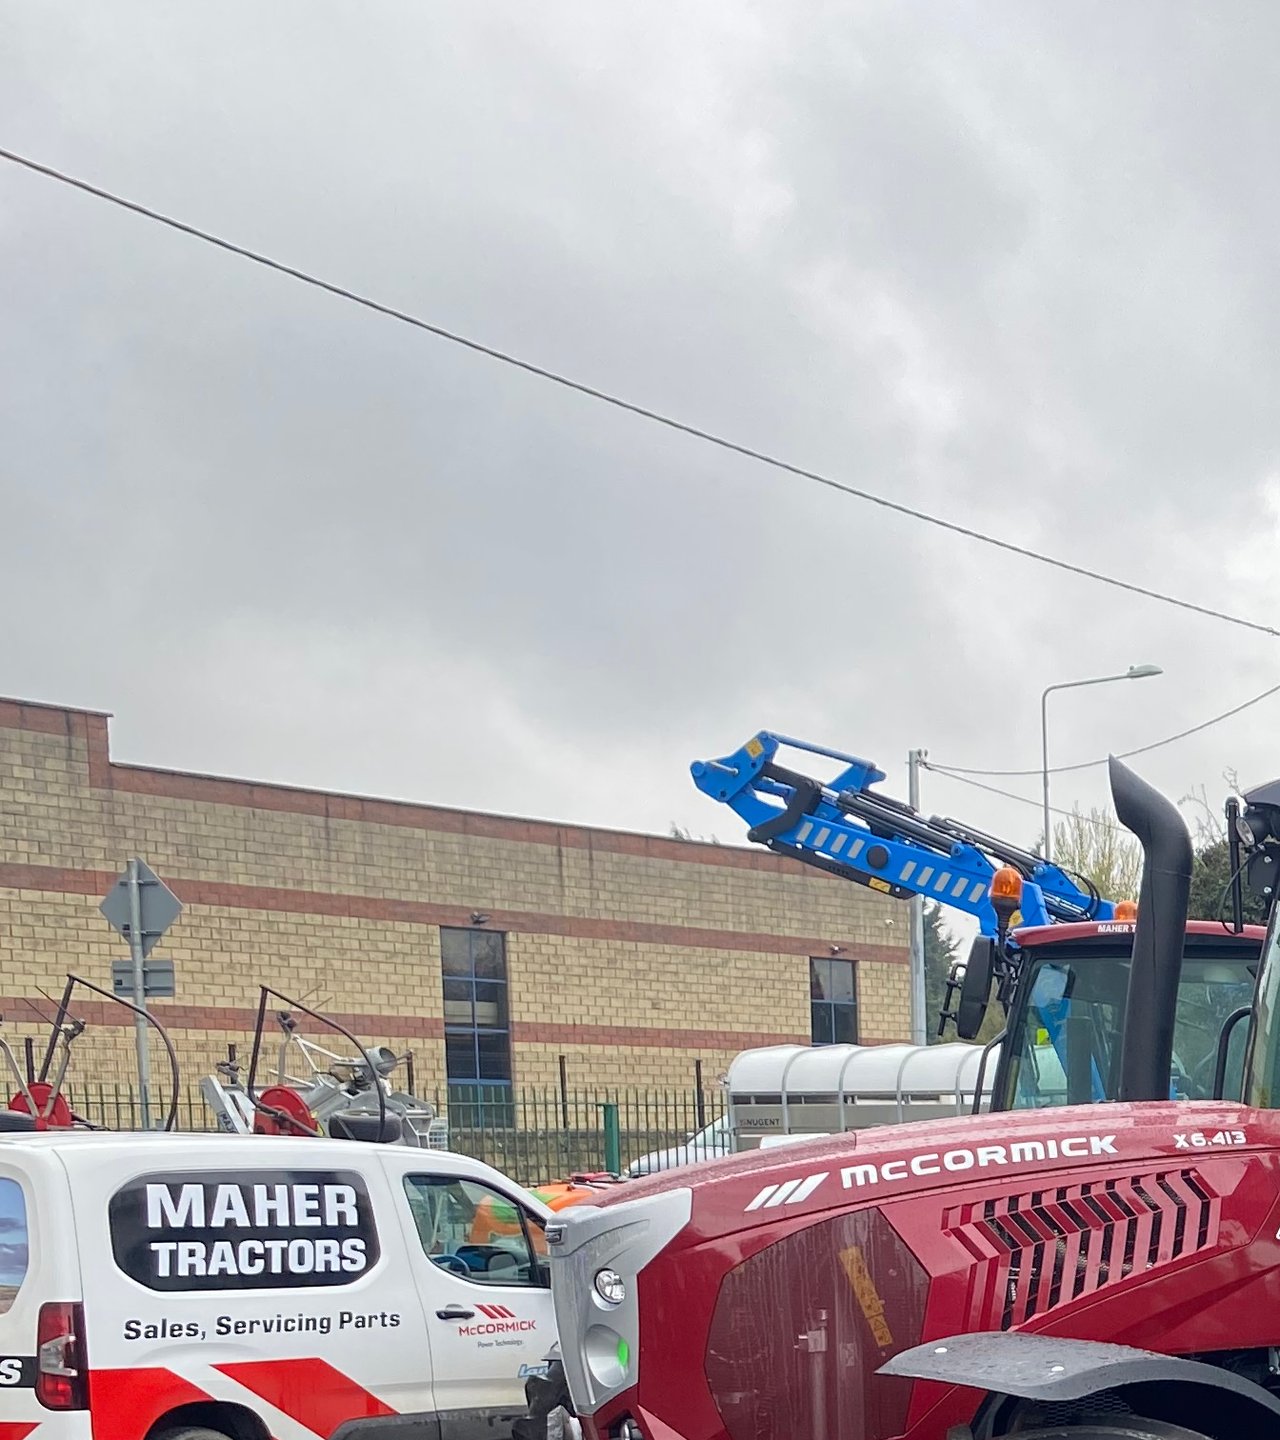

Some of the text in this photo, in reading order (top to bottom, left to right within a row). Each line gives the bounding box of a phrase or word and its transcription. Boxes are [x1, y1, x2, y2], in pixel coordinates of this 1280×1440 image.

[146, 1183, 359, 1229] MAHER
[151, 1238, 366, 1278] TRACTORS
[124, 1310, 400, 1340] Sales, Servicing Parts
[459, 1320, 536, 1336] McCORMICK
